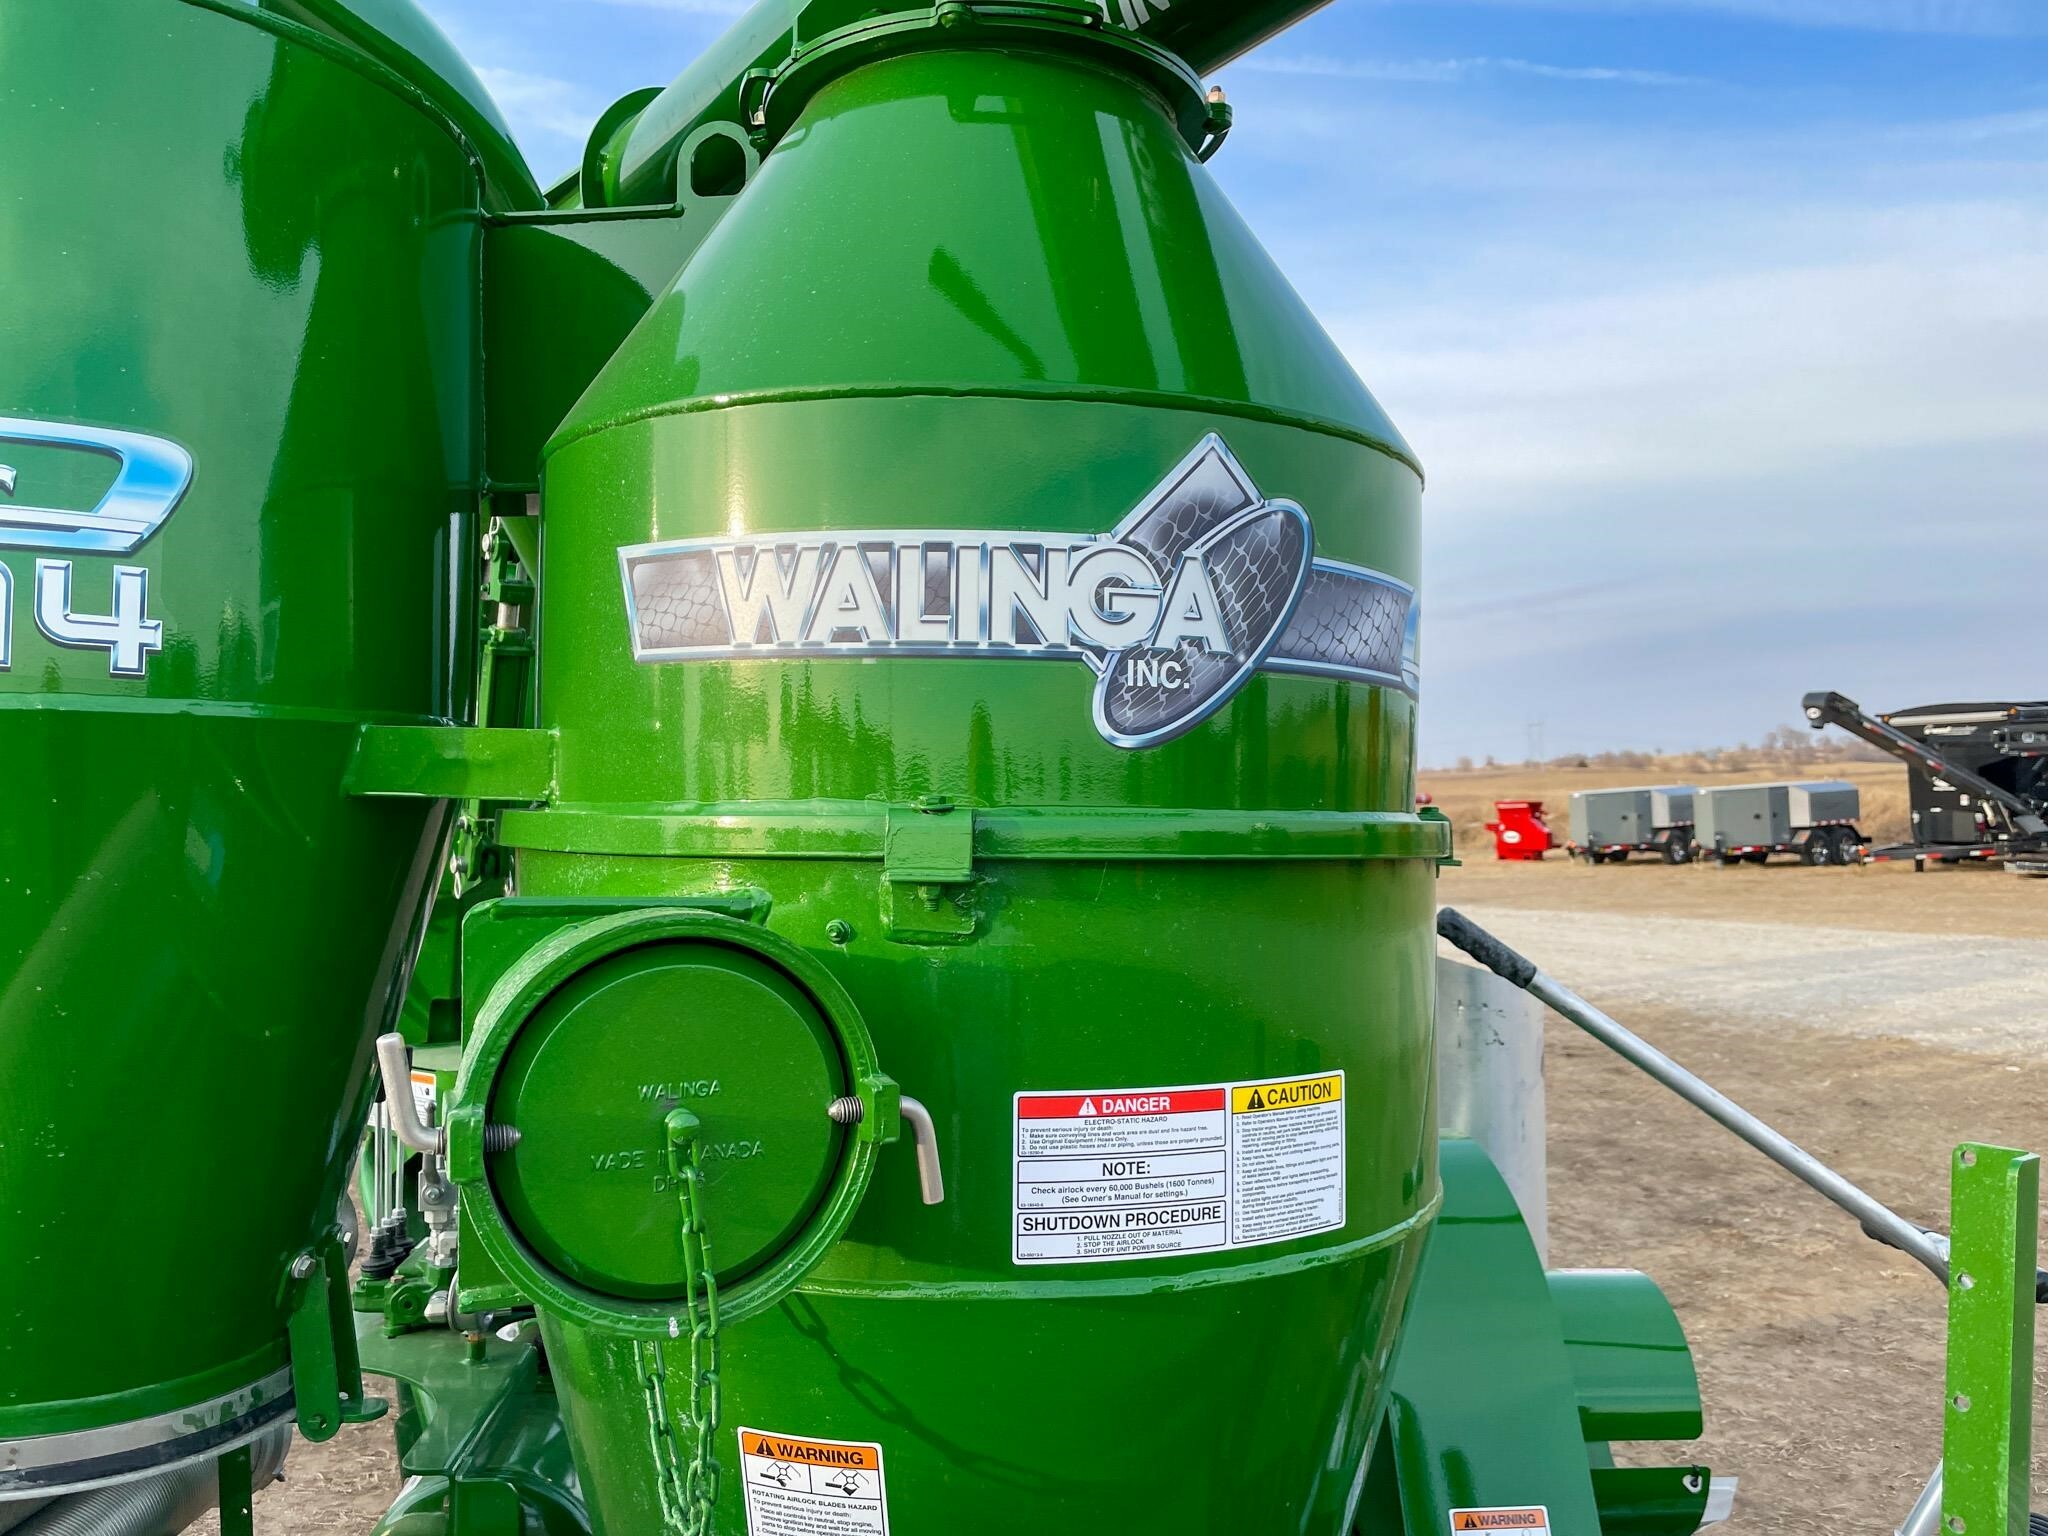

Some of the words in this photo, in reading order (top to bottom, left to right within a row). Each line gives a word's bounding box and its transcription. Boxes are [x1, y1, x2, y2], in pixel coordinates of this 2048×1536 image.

[716, 541, 1233, 656] WALINGA
[1127, 659, 1190, 689] INC.
[637, 1079, 721, 1102] WALINGA
[1267, 1081, 1332, 1105] CAUTION
[1102, 1096, 1171, 1114] DANGER
[1084, 1117, 1140, 1126] ELECTRO-STATIC
[1101, 1161, 1151, 1177] NOTE:
[1031, 1186, 1056, 1194] Check
[1057, 1185, 1084, 1193] airlock
[1086, 1184, 1107, 1194] every
[1135, 1181, 1164, 1190] Bushels
[1166, 1180, 1185, 1190] (1600
[1187, 1178, 1215, 1188] Tonnes)
[1061, 1195, 1079, 1204] (See
[1081, 1194, 1112, 1202] Owner's
[1114, 1192, 1141, 1201] Manual
[1023, 1213, 1121, 1232] SHUTDOWN
[1125, 1206, 1222, 1226] PROCEDURE
[1151, 1229, 1183, 1237] MATERIAL
[776, 1442, 864, 1465] WARNING
[751, 1490, 785, 1500] ROTATING
[786, 1496, 816, 1505] AIRLOCK
[818, 1500, 846, 1508] BLADES
[847, 1503, 878, 1511] HAZARD
[1477, 1514, 1537, 1526] WARNING
